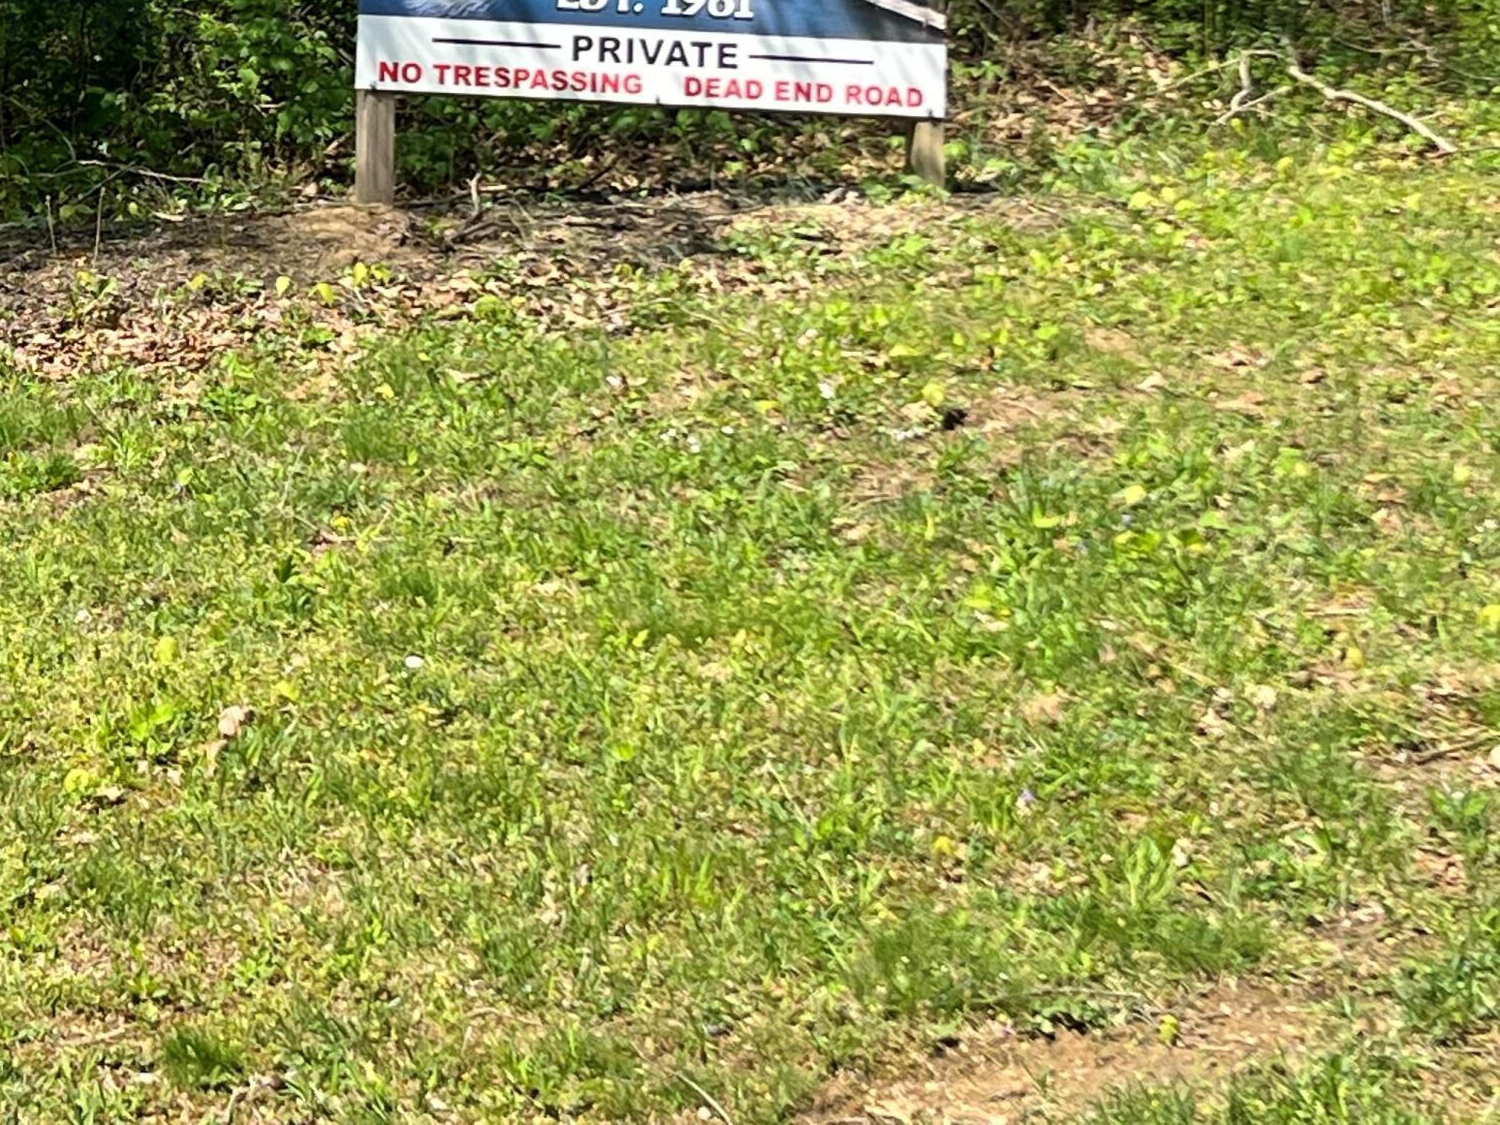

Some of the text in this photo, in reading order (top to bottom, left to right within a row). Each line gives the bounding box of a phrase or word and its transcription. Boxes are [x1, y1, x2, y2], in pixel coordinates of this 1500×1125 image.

[571, 34, 740, 70] PRIVATE
[378, 61, 643, 96] NO TRESPASSING
[683, 75, 925, 109] DEAD END ROAD
